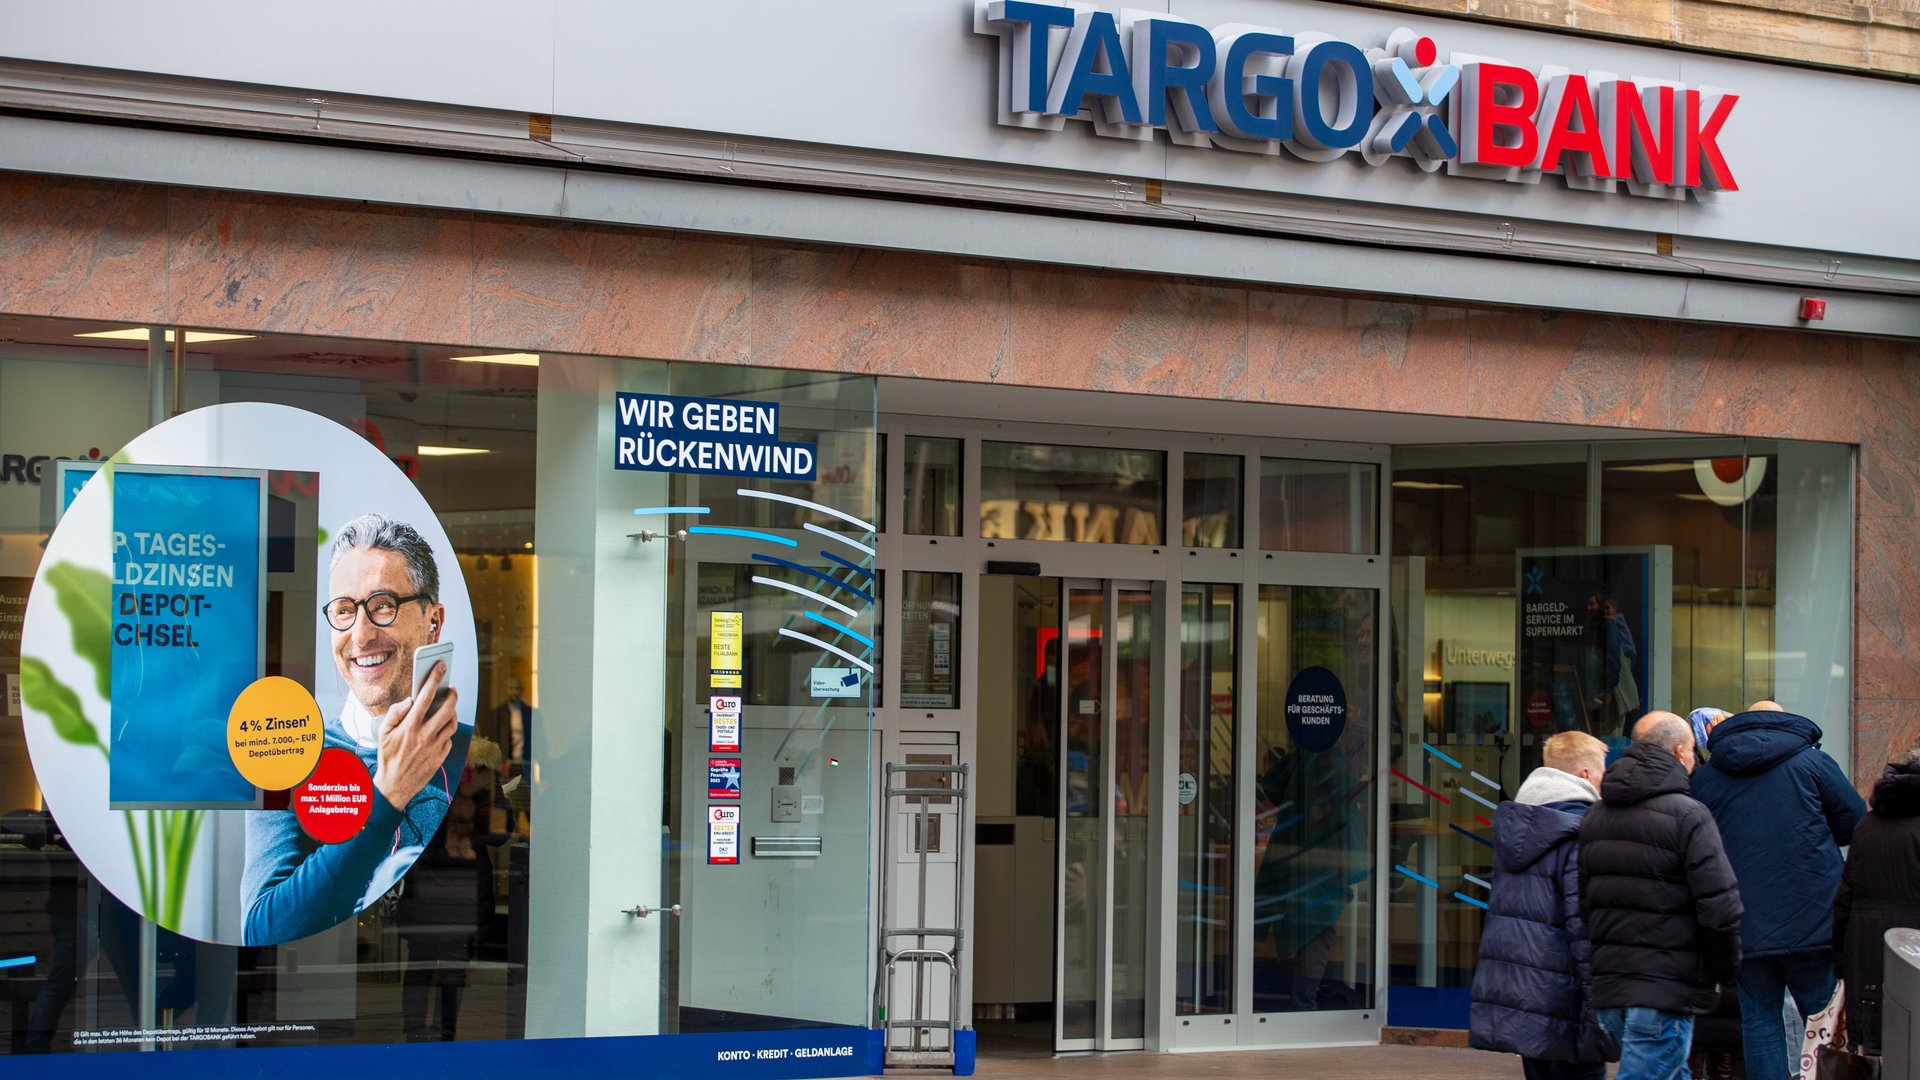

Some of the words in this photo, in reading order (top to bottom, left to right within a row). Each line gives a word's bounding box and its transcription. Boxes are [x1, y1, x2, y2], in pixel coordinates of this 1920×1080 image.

[1476, 62, 1739, 192] BANK
[618, 397, 674, 429] WIR
[682, 402, 775, 435] GEBEN
[619, 431, 813, 475] RÜCKENWIND
[133, 532, 226, 557] TAGES-
[120, 592, 212, 617] DEPOT-
[1526, 602, 1569, 613] BARGELD-
[1526, 614, 1561, 625] SERVICE
[1563, 614, 1575, 624] IM
[112, 622, 199, 647] CHSEL
[1526, 626, 1584, 636] SUPERMARKT
[1298, 695, 1334, 703] BERATUNG
[1288, 704, 1300, 713] FÜR
[1302, 704, 1344, 714] GESCHÄFTS-
[1301, 716, 1330, 725] KUNDEN
[235, 738, 247, 747] bei
[248, 737, 270, 746] mind.
[301, 733, 317, 742] EUR
[248, 747, 305, 759] Depotübertrag
[307, 783, 348, 792] Sonderzins
[349, 784, 361, 792] bis
[301, 795, 319, 803] max.
[325, 795, 351, 803] Million
[352, 795, 367, 803] EUR
[309, 805, 359, 815] Anlagebetrag
[717, 1050, 750, 1061] KONTO
[756, 1049, 788, 1059] KREDIT
[795, 1046, 853, 1058] GELDANLAGE
